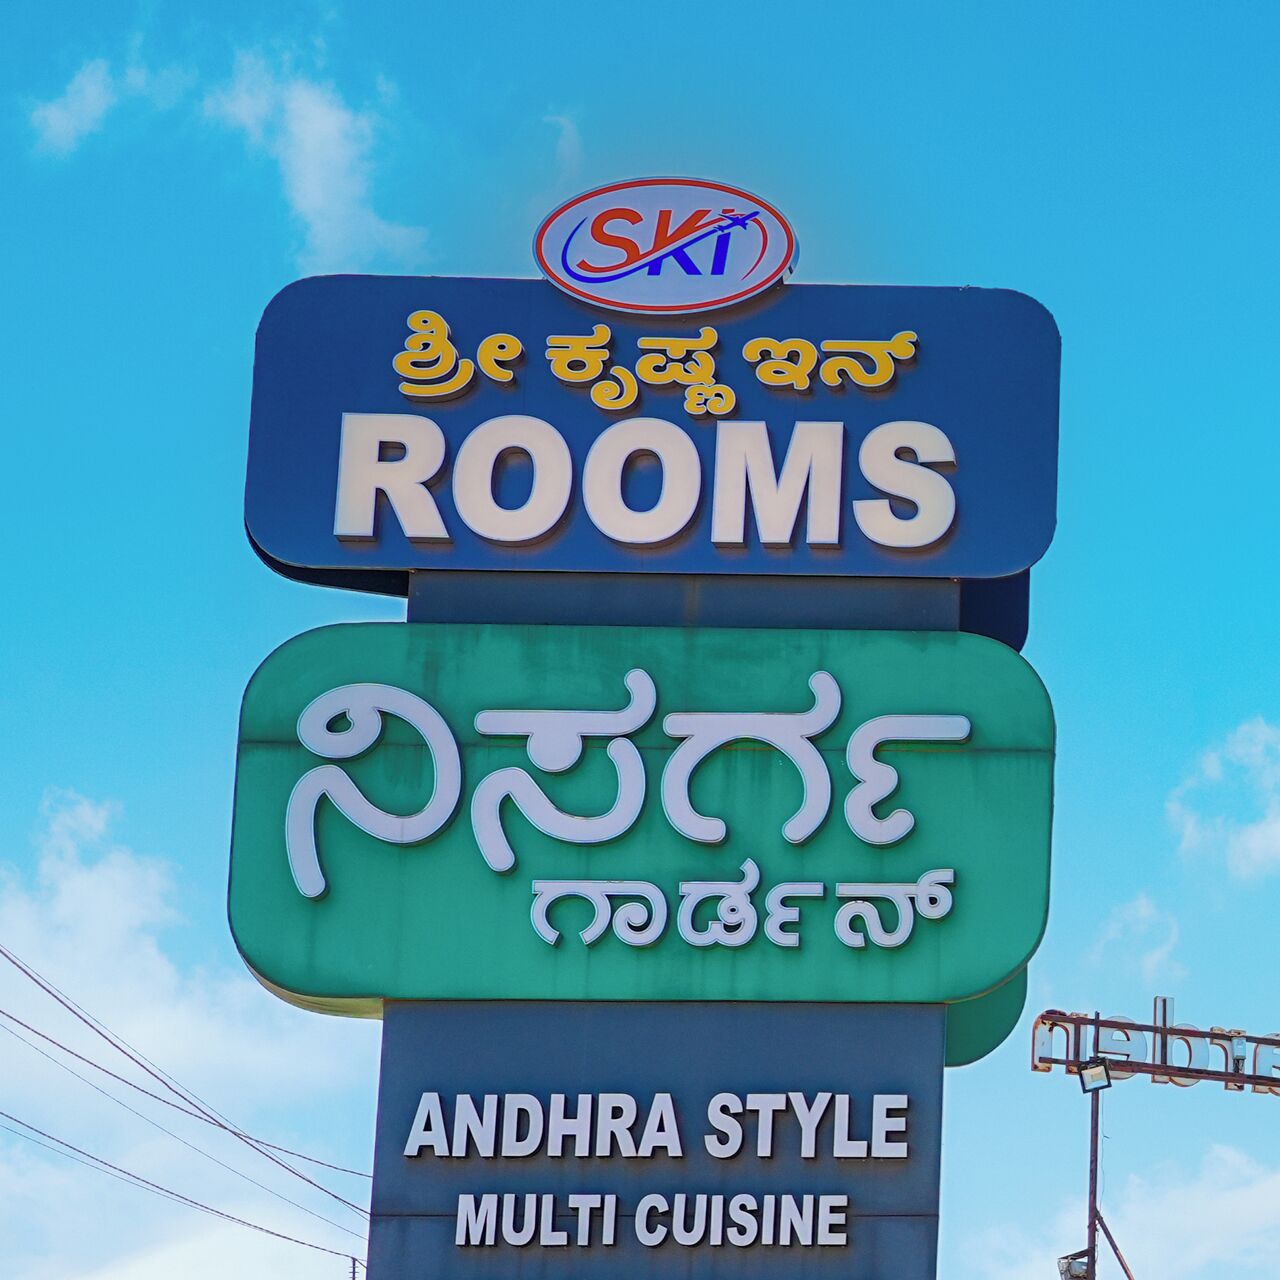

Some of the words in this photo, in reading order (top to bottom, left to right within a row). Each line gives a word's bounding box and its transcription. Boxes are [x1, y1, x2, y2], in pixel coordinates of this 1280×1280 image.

[393, 309, 521, 398] ಶ್ರೀ
[546, 323, 737, 415] ಕೃಷ್ಣ
[742, 330, 919, 390] ಇನ್
[333, 412, 957, 548] ROOMS
[284, 668, 972, 900] ನಿಸರ್ಗ
[531, 858, 955, 948] ಗಾರ್ಡನ್
[403, 1092, 683, 1159] ANDHRA
[703, 1092, 909, 1159] STYLE
[455, 1194, 617, 1247] MULTI
[634, 1193, 849, 1247] CUISINE
